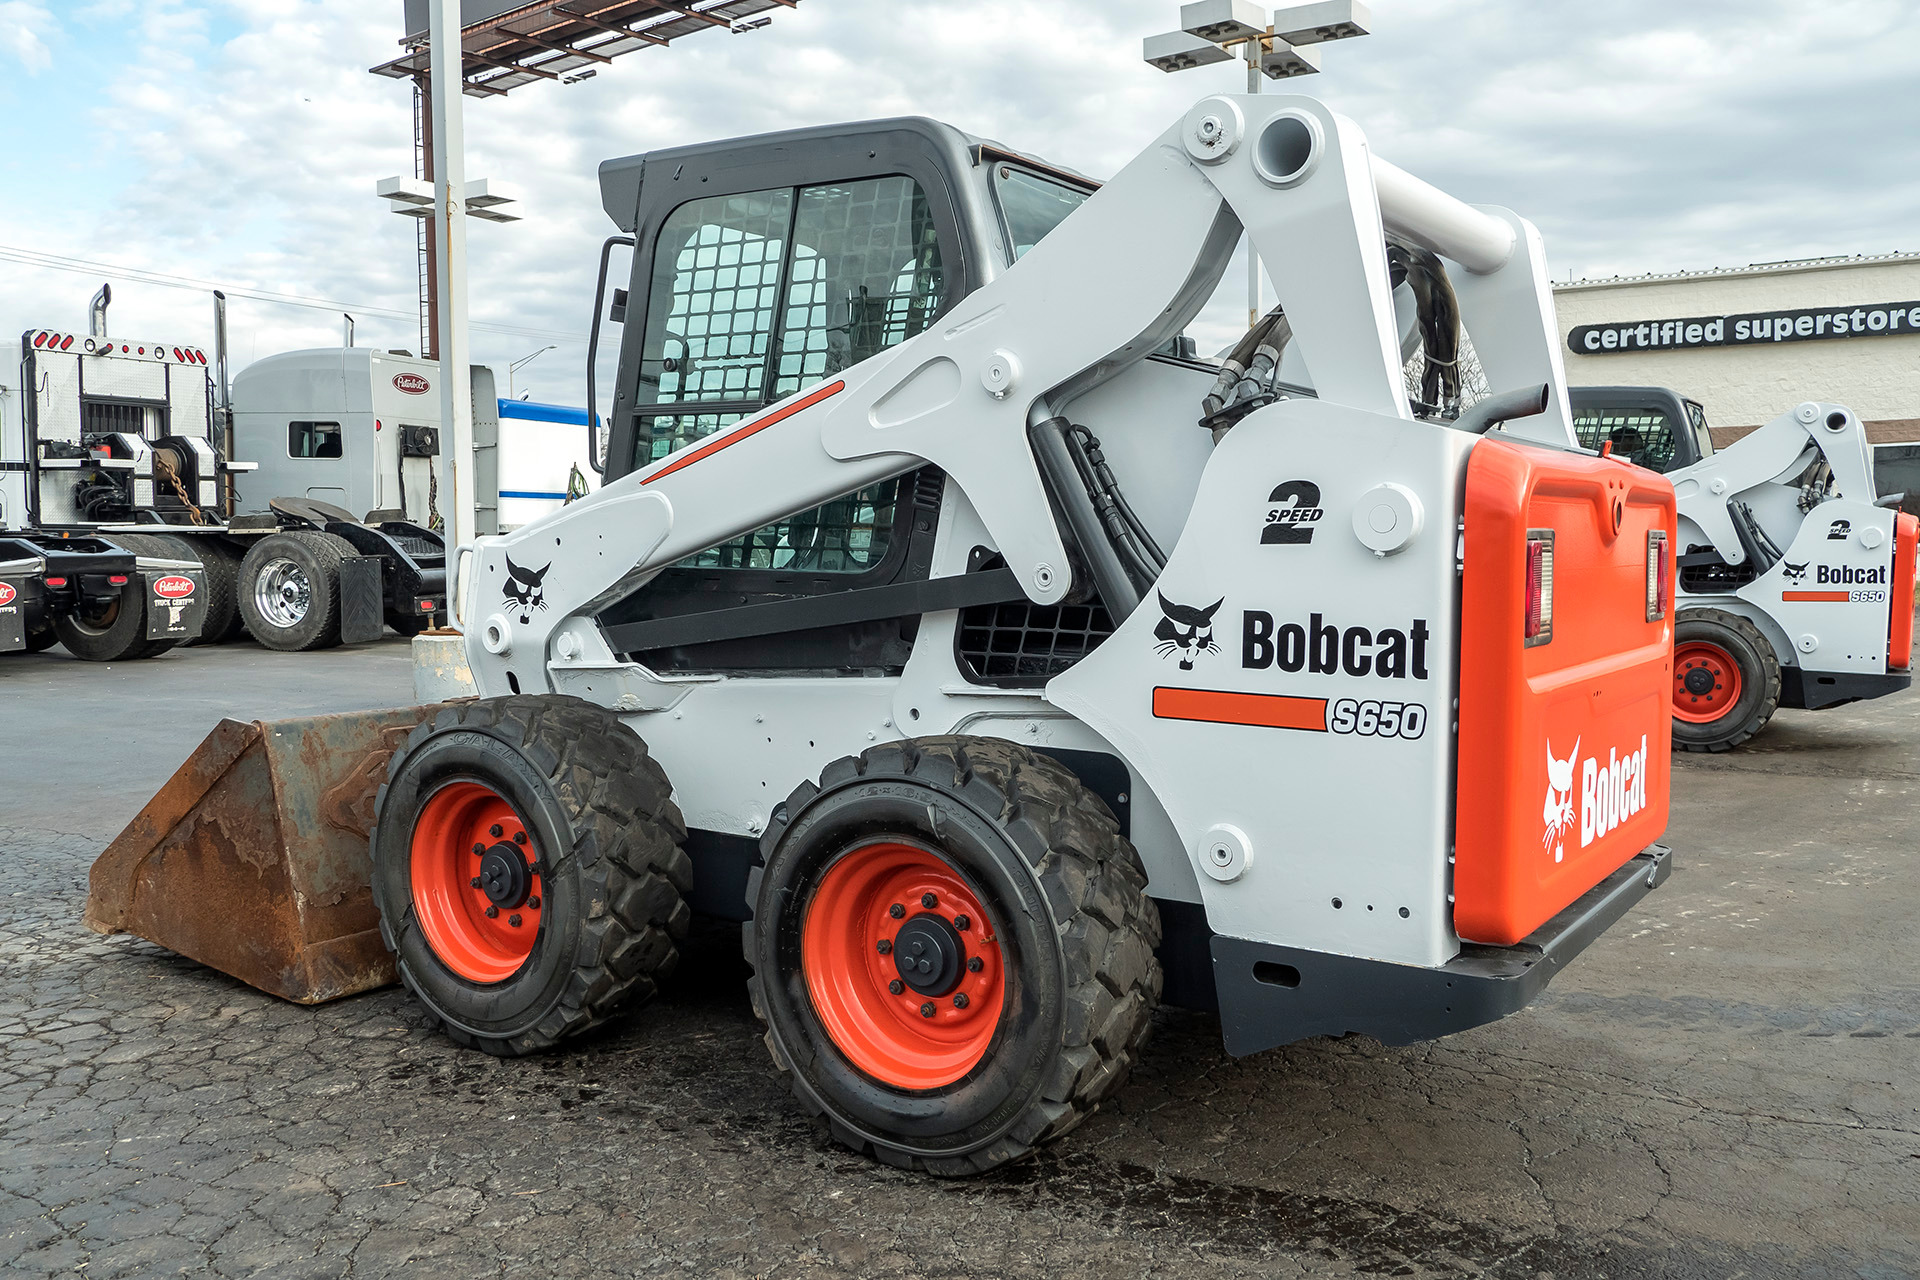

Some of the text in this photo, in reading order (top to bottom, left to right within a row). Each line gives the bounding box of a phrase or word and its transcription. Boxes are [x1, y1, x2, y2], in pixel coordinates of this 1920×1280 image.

[1584, 307, 1920, 350] certified superstore
[397, 376, 427, 390] Peterbilt
[1260, 479, 1324, 544] 2 SPEED
[1827, 519, 1851, 540] 2
[1817, 564, 1886, 584] Bobcat
[159, 580, 191, 593] Peterbilt
[1850, 590, 1886, 603] S650
[154, 599, 171, 607] TRUCK
[1241, 609, 1429, 680] Bobcat
[1331, 697, 1428, 740] S650
[1581, 733, 1647, 849] Bobcat
